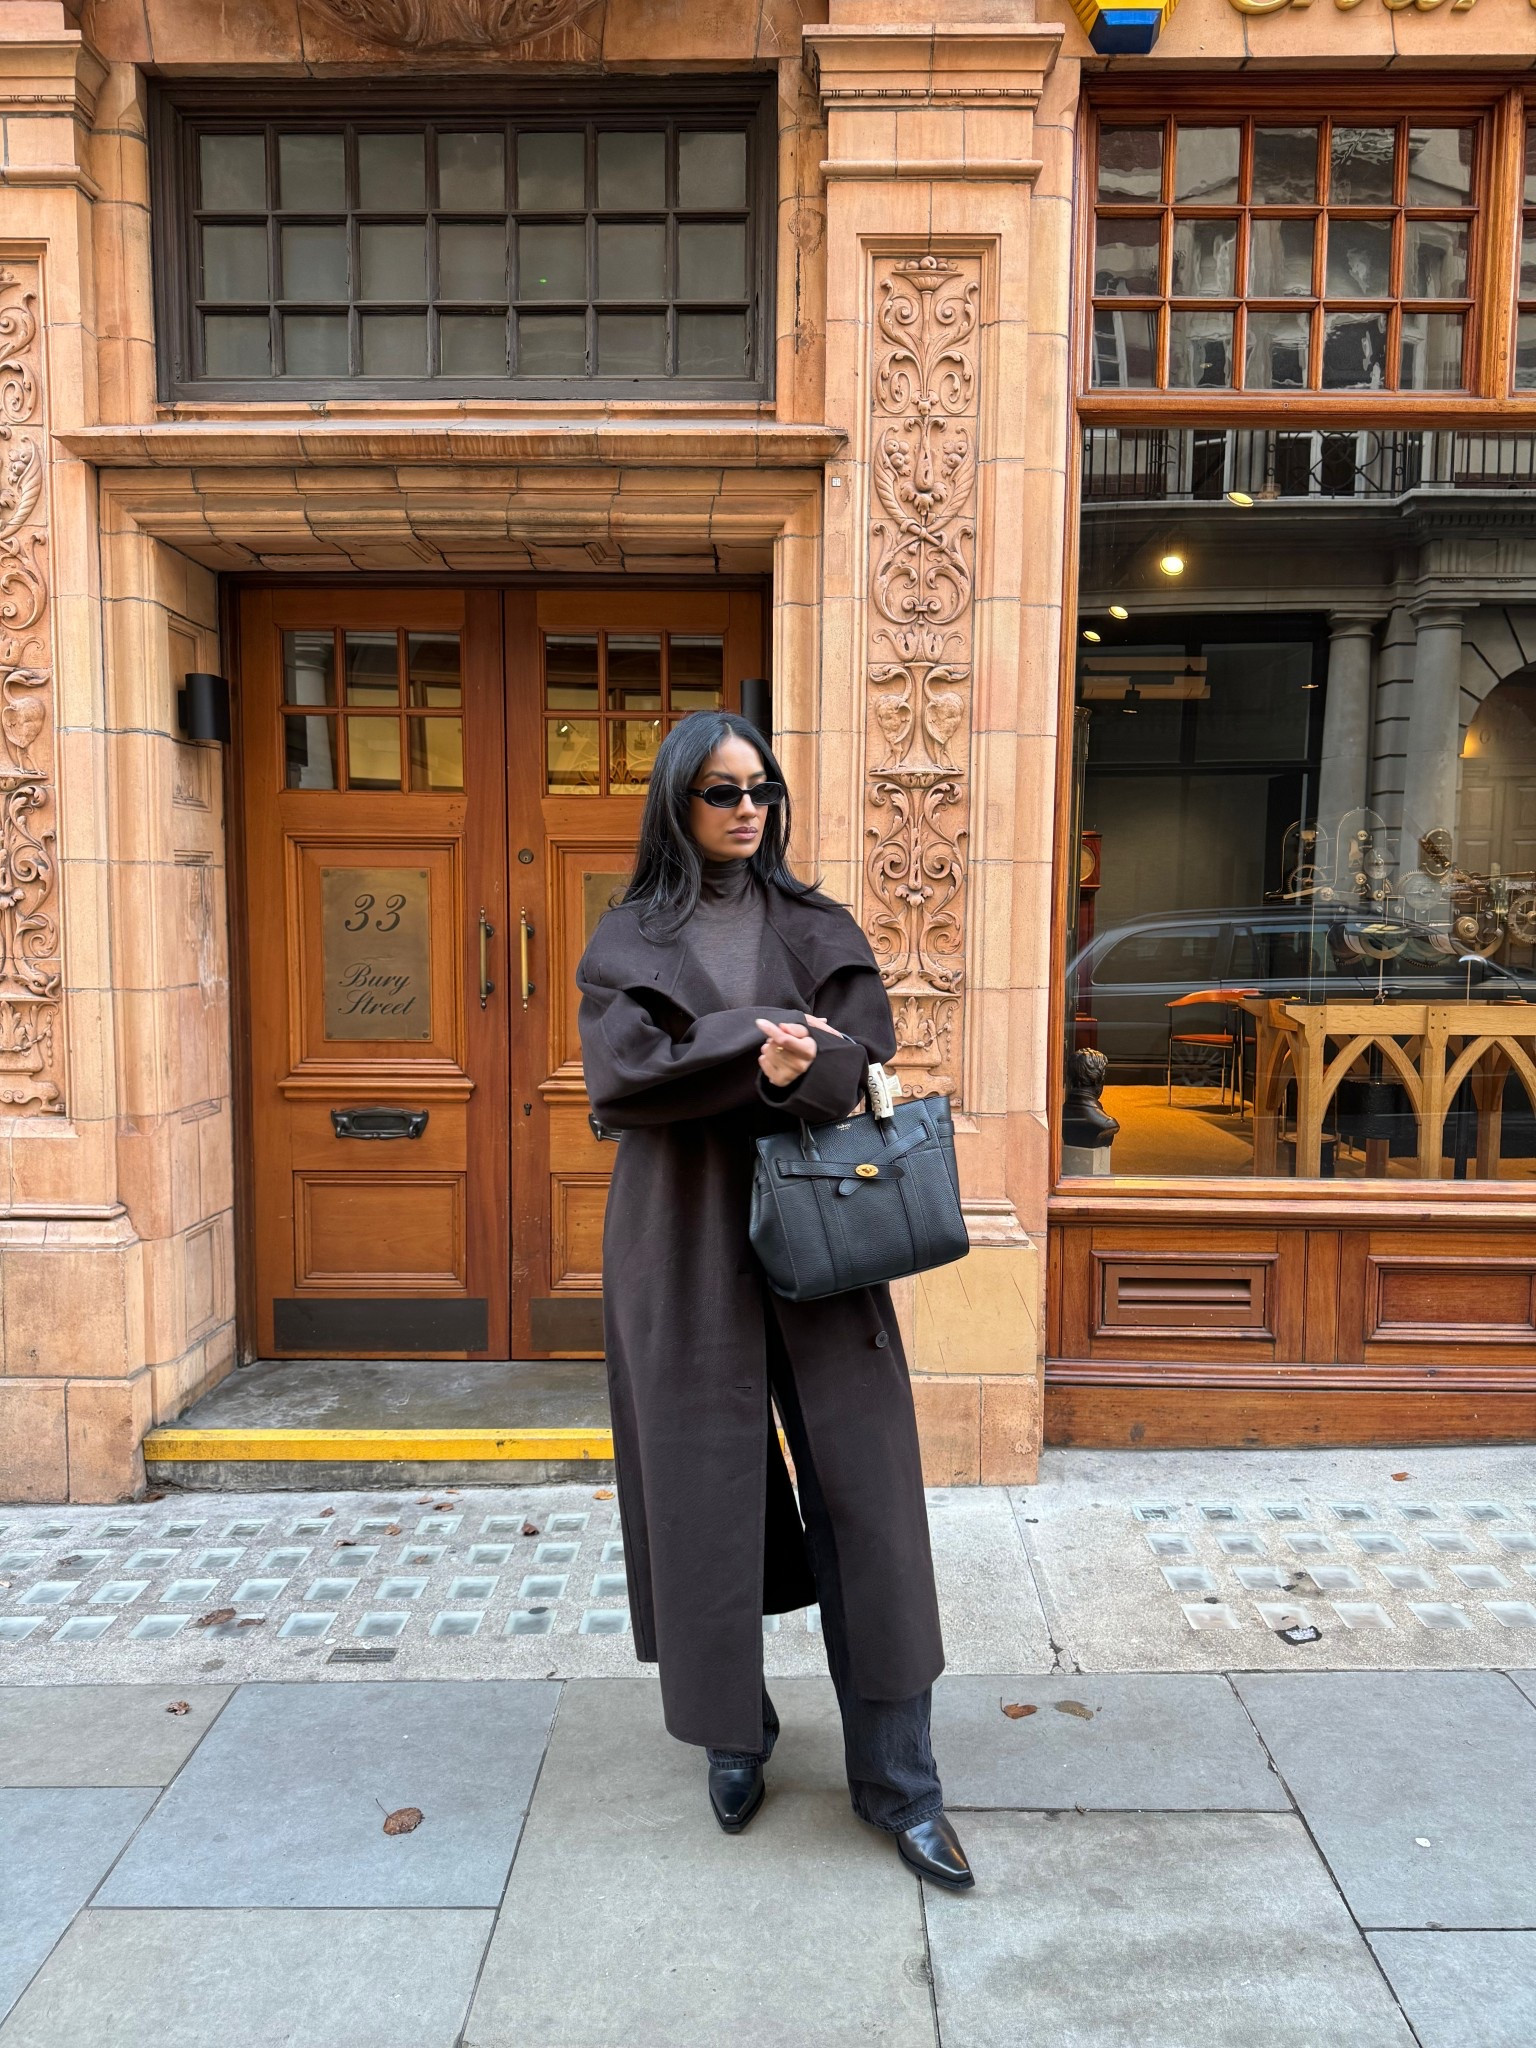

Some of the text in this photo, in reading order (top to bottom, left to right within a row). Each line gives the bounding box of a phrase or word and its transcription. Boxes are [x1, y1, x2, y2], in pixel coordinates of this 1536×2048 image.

[344, 893, 407, 932] 33
[338, 962, 411, 996] Bury
[337, 989, 417, 1015] Street
